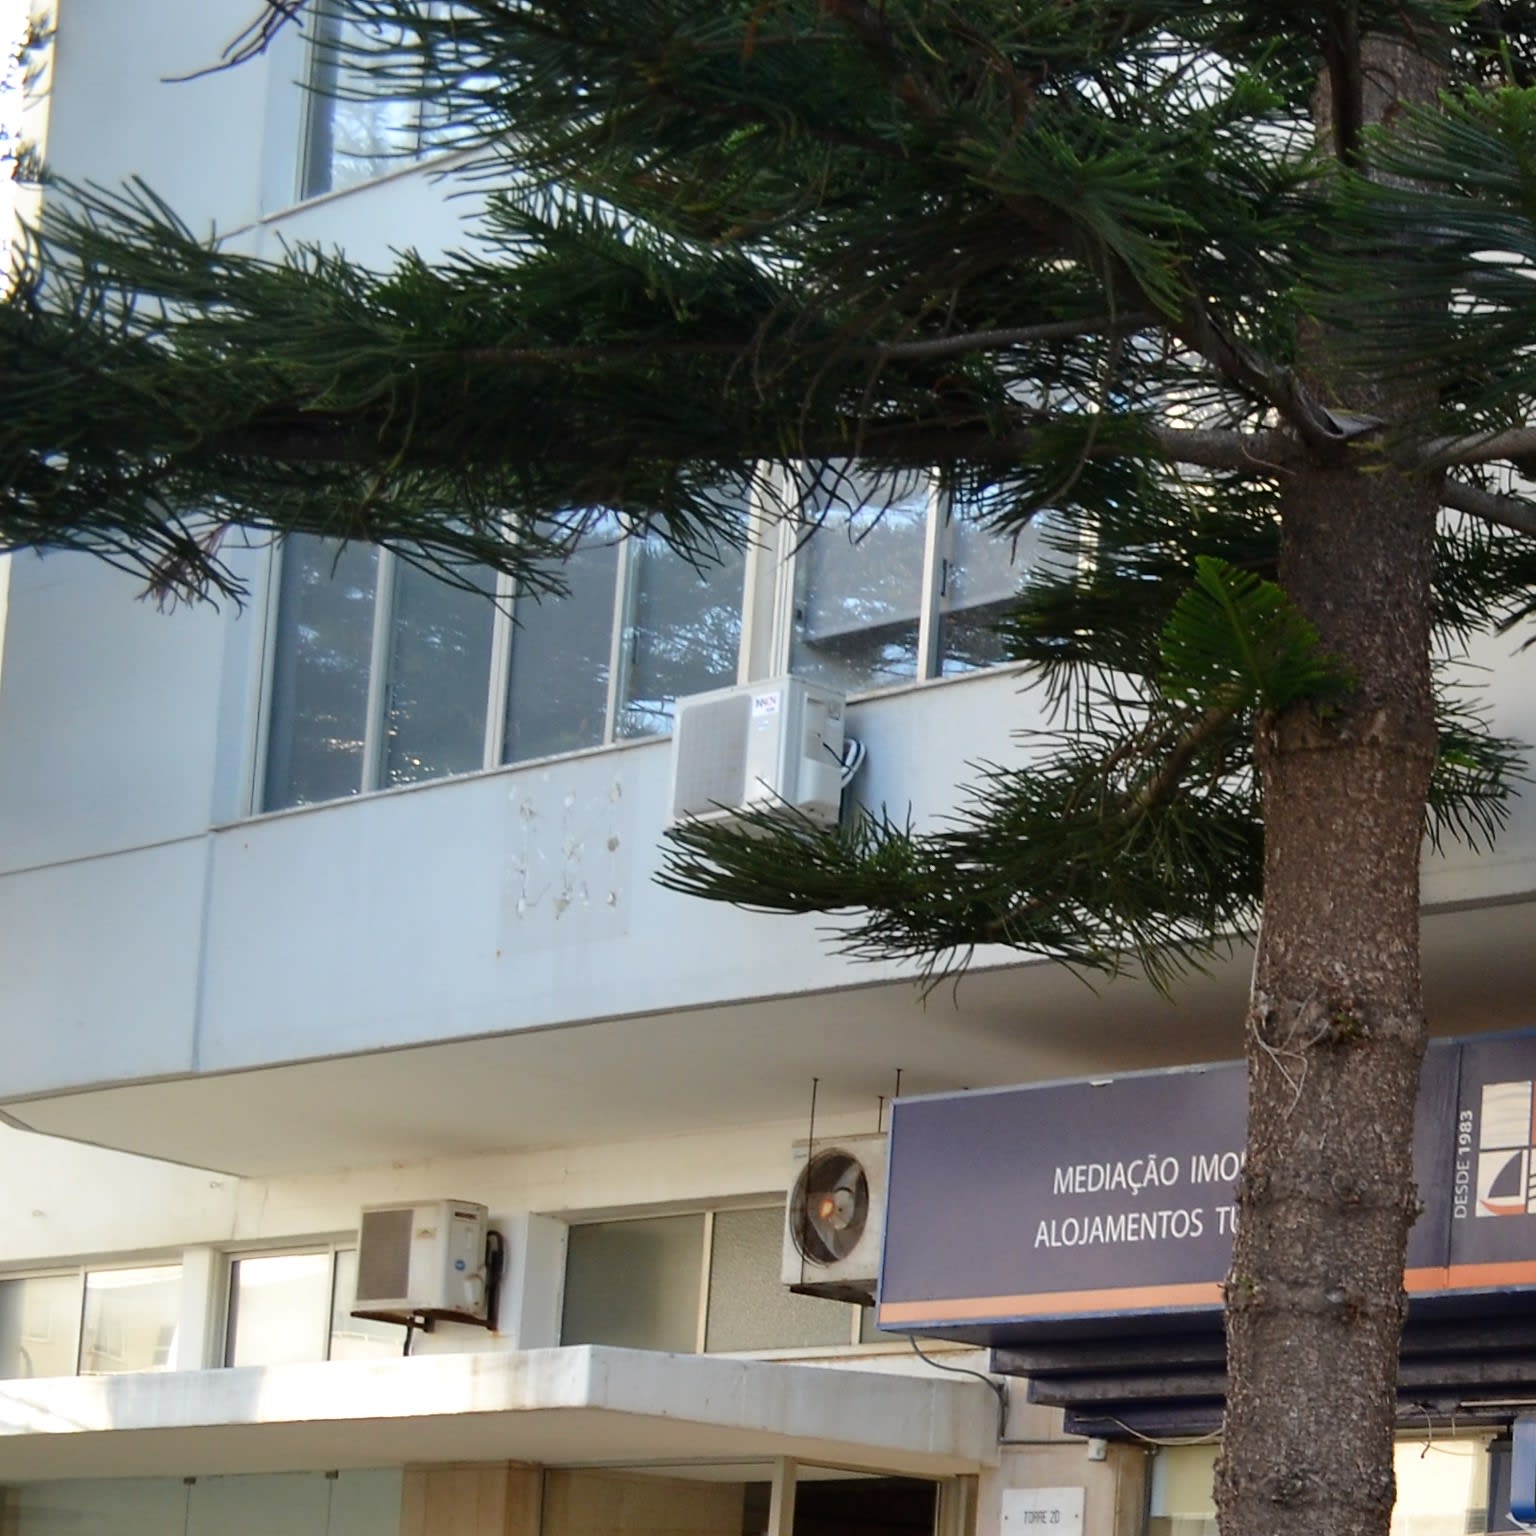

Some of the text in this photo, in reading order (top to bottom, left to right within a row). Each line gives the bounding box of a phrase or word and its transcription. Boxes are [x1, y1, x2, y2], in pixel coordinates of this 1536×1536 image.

[1053, 1150, 1246, 1196] MEDIAÇÃO IMO
[1453, 1109, 1473, 1219] DESDE 1983
[1034, 1207, 1204, 1249] ALOJAMENTOS
